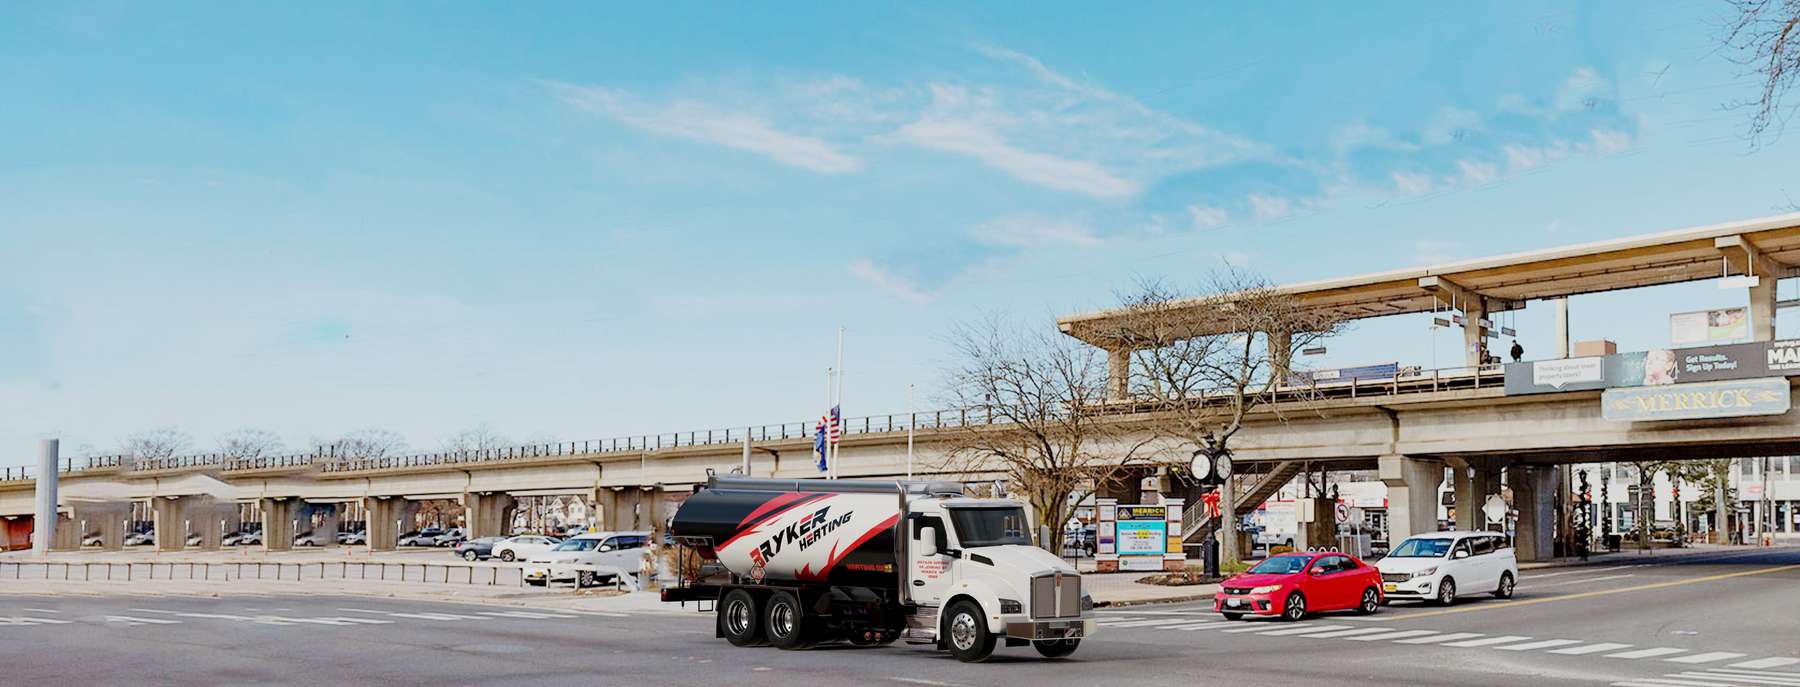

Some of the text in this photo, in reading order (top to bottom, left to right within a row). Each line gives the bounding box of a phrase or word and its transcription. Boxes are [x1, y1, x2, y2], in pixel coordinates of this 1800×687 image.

[1686, 355, 1698, 363] Get
[1768, 348, 1800, 364] MA
[1686, 363, 1701, 373] Sign
[1636, 388, 1752, 412] MERRICK
[799, 511, 854, 552] HEATING
